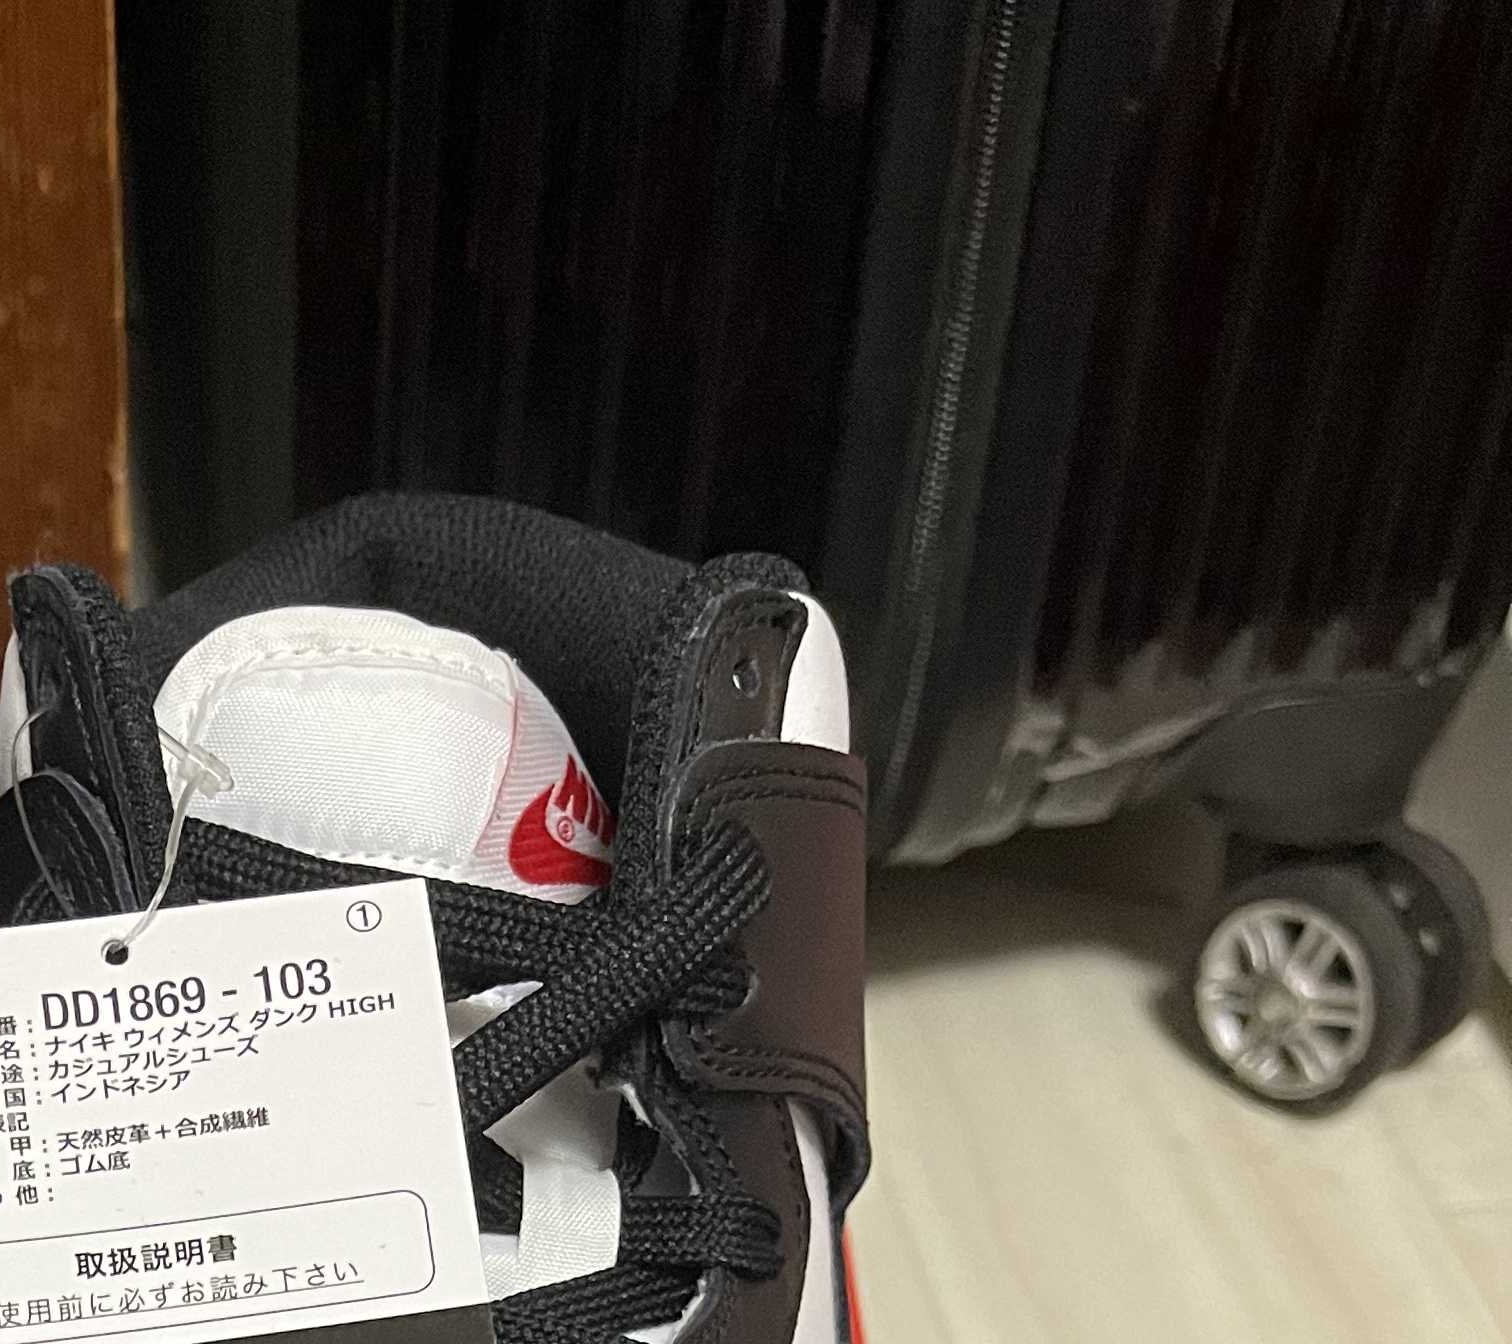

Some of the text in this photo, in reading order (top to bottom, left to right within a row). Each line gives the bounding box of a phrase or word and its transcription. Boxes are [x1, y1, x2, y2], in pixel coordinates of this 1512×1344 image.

[41, 976, 206, 1031] DD1869
[253, 958, 332, 1003] 103
[45, 1031, 115, 1057] ナイキ
[124, 1012, 240, 1049] ウィメンズ
[250, 1002, 317, 1032] ダンク
[328, 992, 396, 1019] HIGH
[49, 1034, 259, 1081] カジュアルシューズ
[51, 1069, 191, 1104] インドネシア
[59, 1150, 131, 1176] ゴム底
[75, 1234, 238, 1279] 取扱説明書
